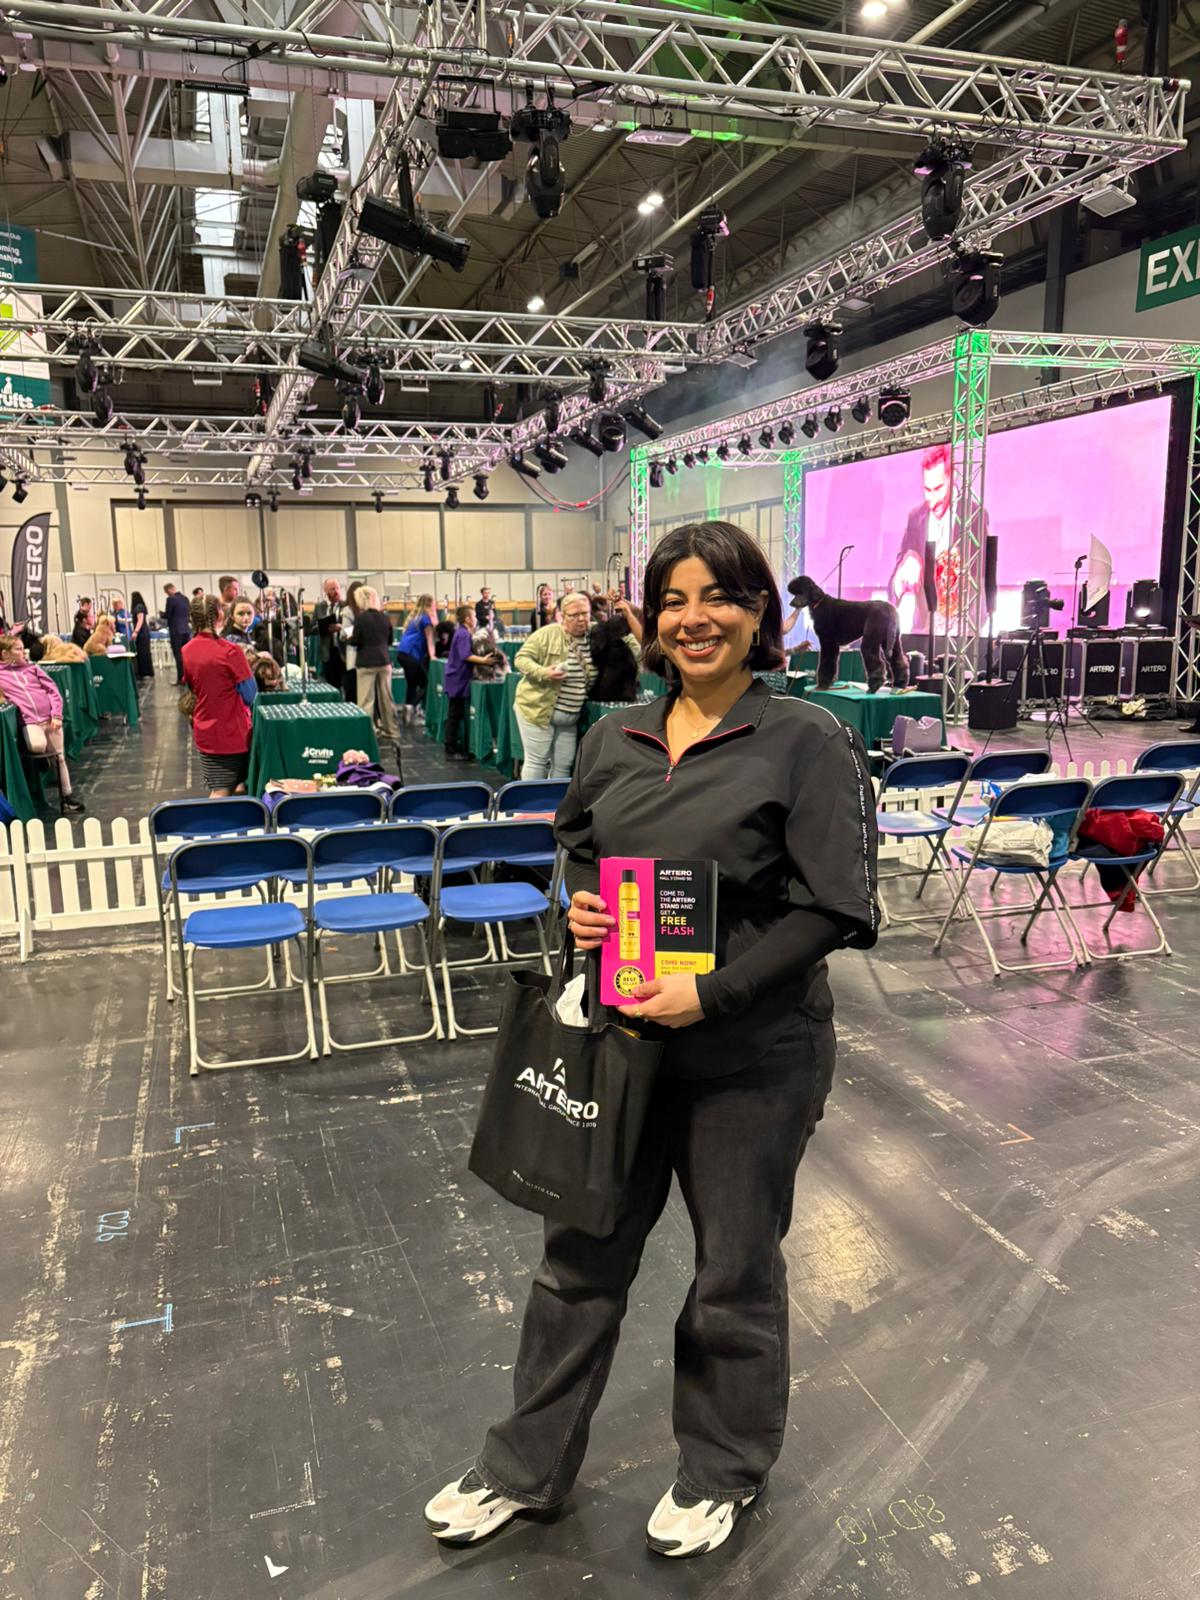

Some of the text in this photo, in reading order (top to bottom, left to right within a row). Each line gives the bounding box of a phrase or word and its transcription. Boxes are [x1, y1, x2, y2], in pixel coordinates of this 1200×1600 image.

[26, 525, 43, 634] ARTERO
[1089, 665, 1115, 673] ARTERO
[1140, 664, 1167, 673] ARTERO
[309, 747, 334, 758] Crufts
[660, 916, 687, 926] FREE
[661, 926, 695, 936] FLASH
